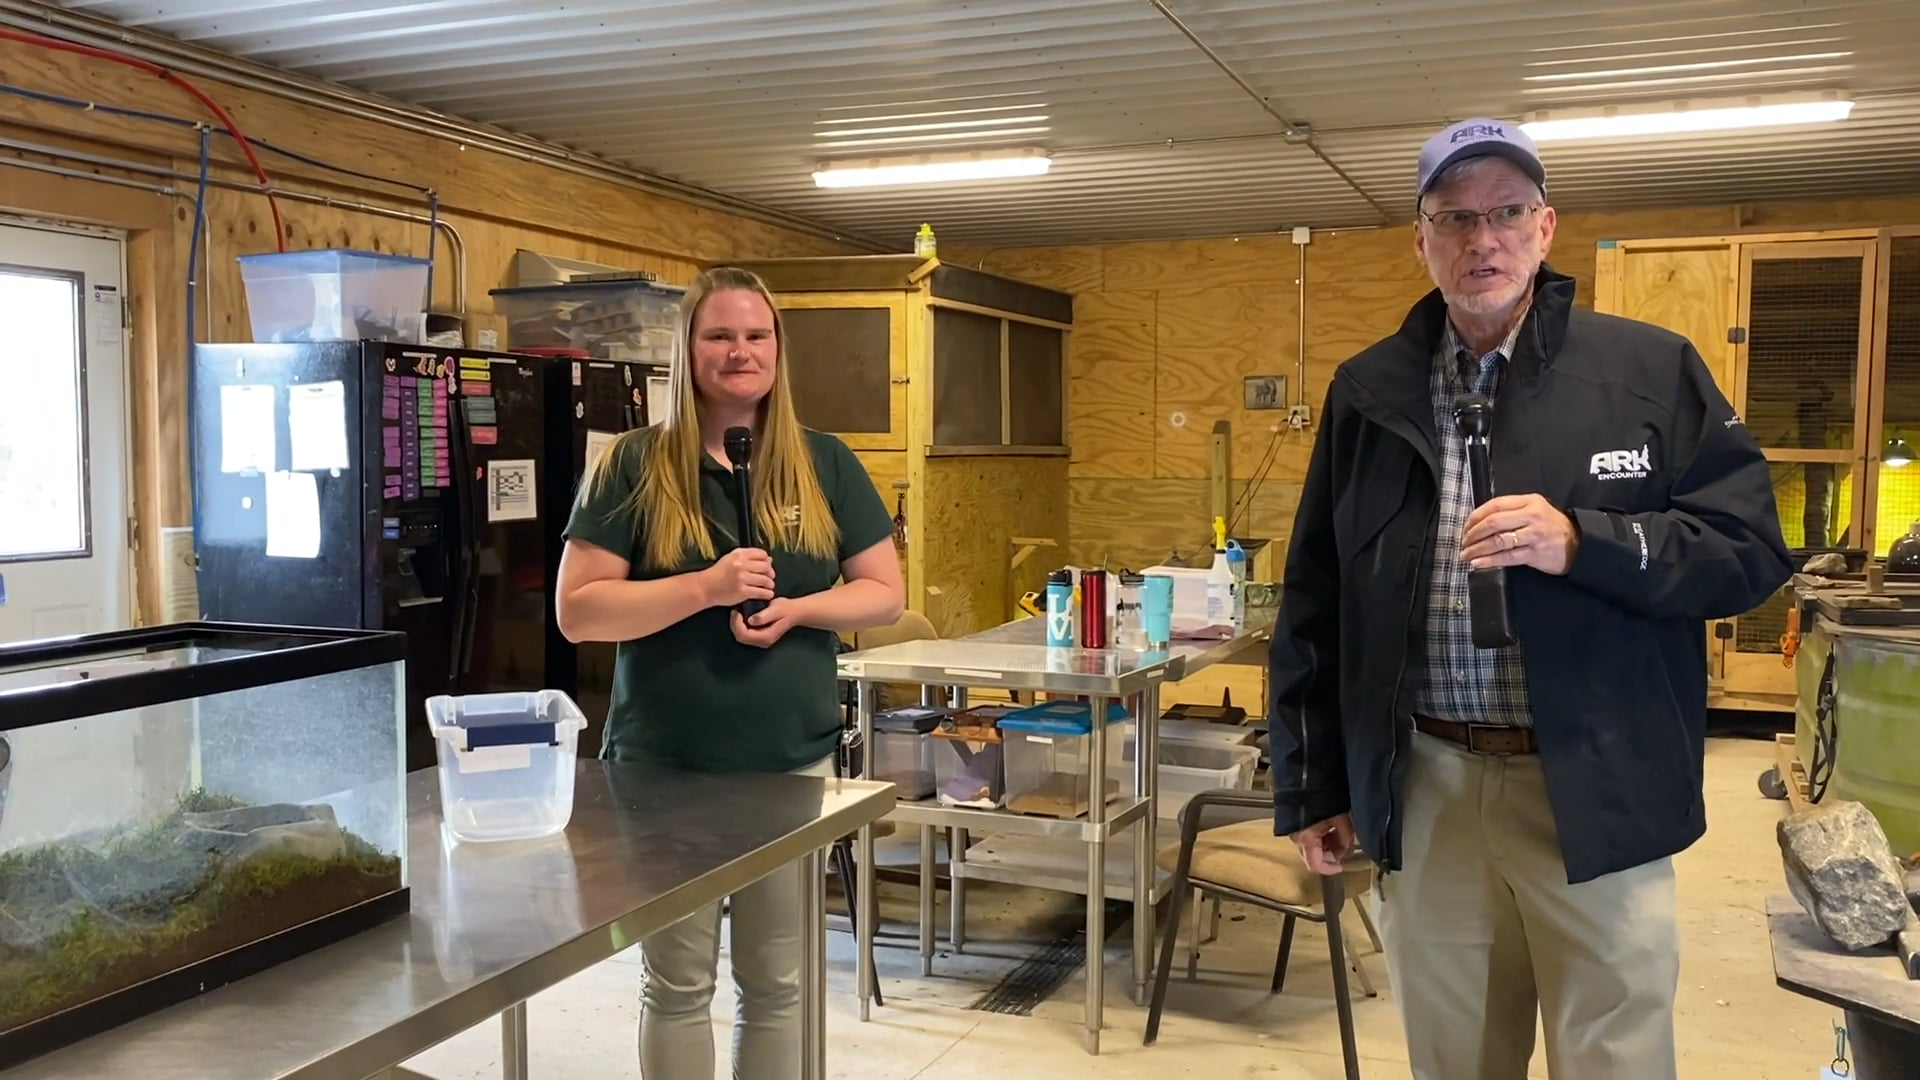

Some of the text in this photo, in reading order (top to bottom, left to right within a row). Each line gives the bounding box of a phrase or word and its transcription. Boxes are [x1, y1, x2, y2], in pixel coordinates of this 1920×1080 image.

[1450, 124, 1505, 143] ARK
[1590, 444, 1652, 475] ARK
[1597, 471, 1647, 481] ENCOUNTER
